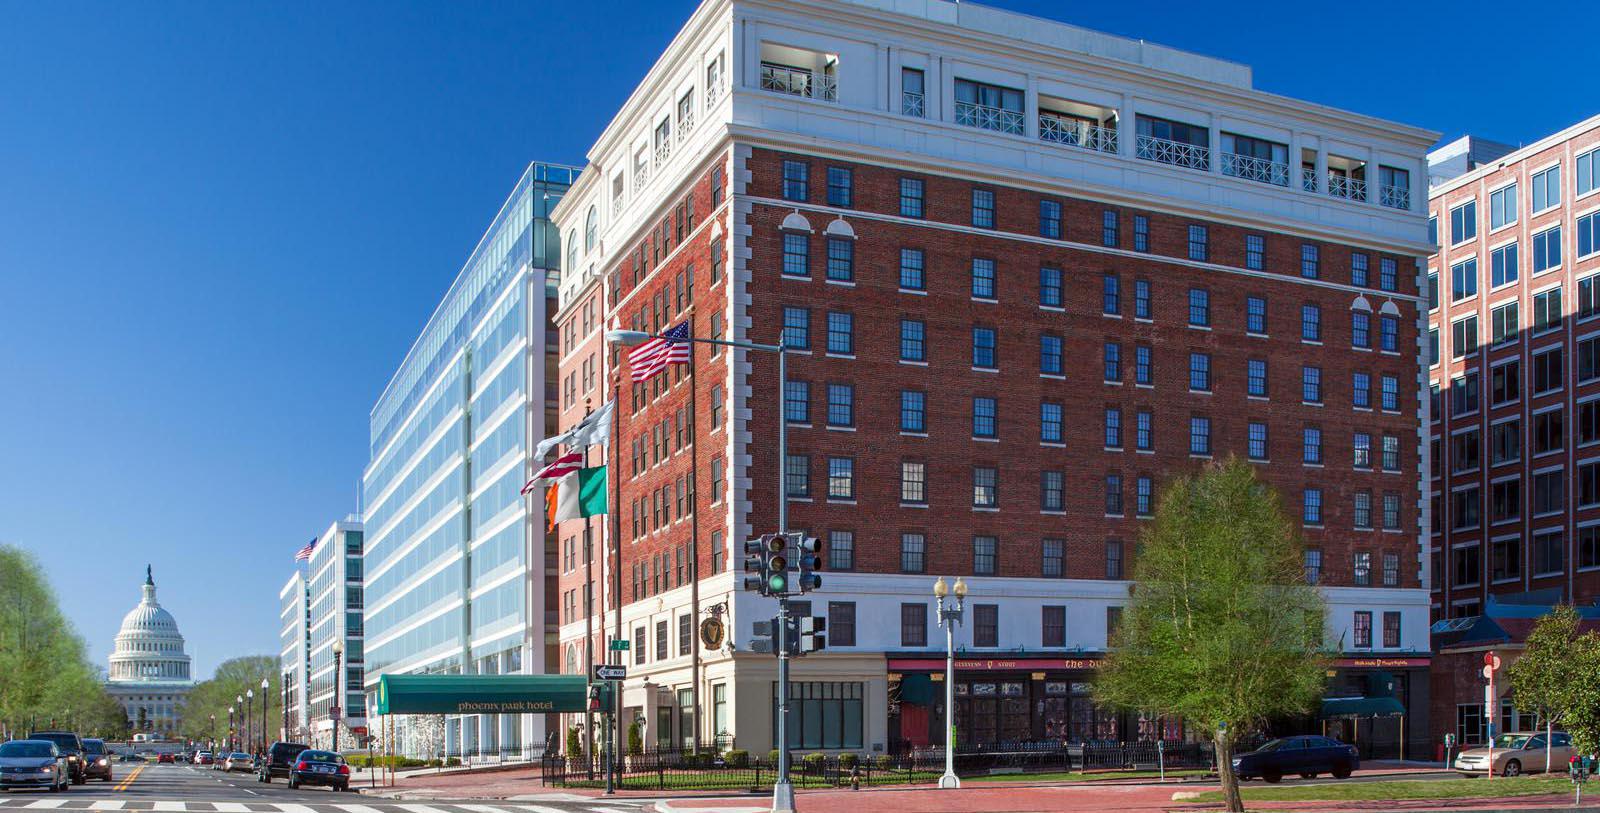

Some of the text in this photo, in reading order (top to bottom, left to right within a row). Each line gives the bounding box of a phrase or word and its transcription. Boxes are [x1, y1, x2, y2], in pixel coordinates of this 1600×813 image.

[1065, 660, 1083, 668] the
[458, 701, 553, 712] phoenix park hotel
